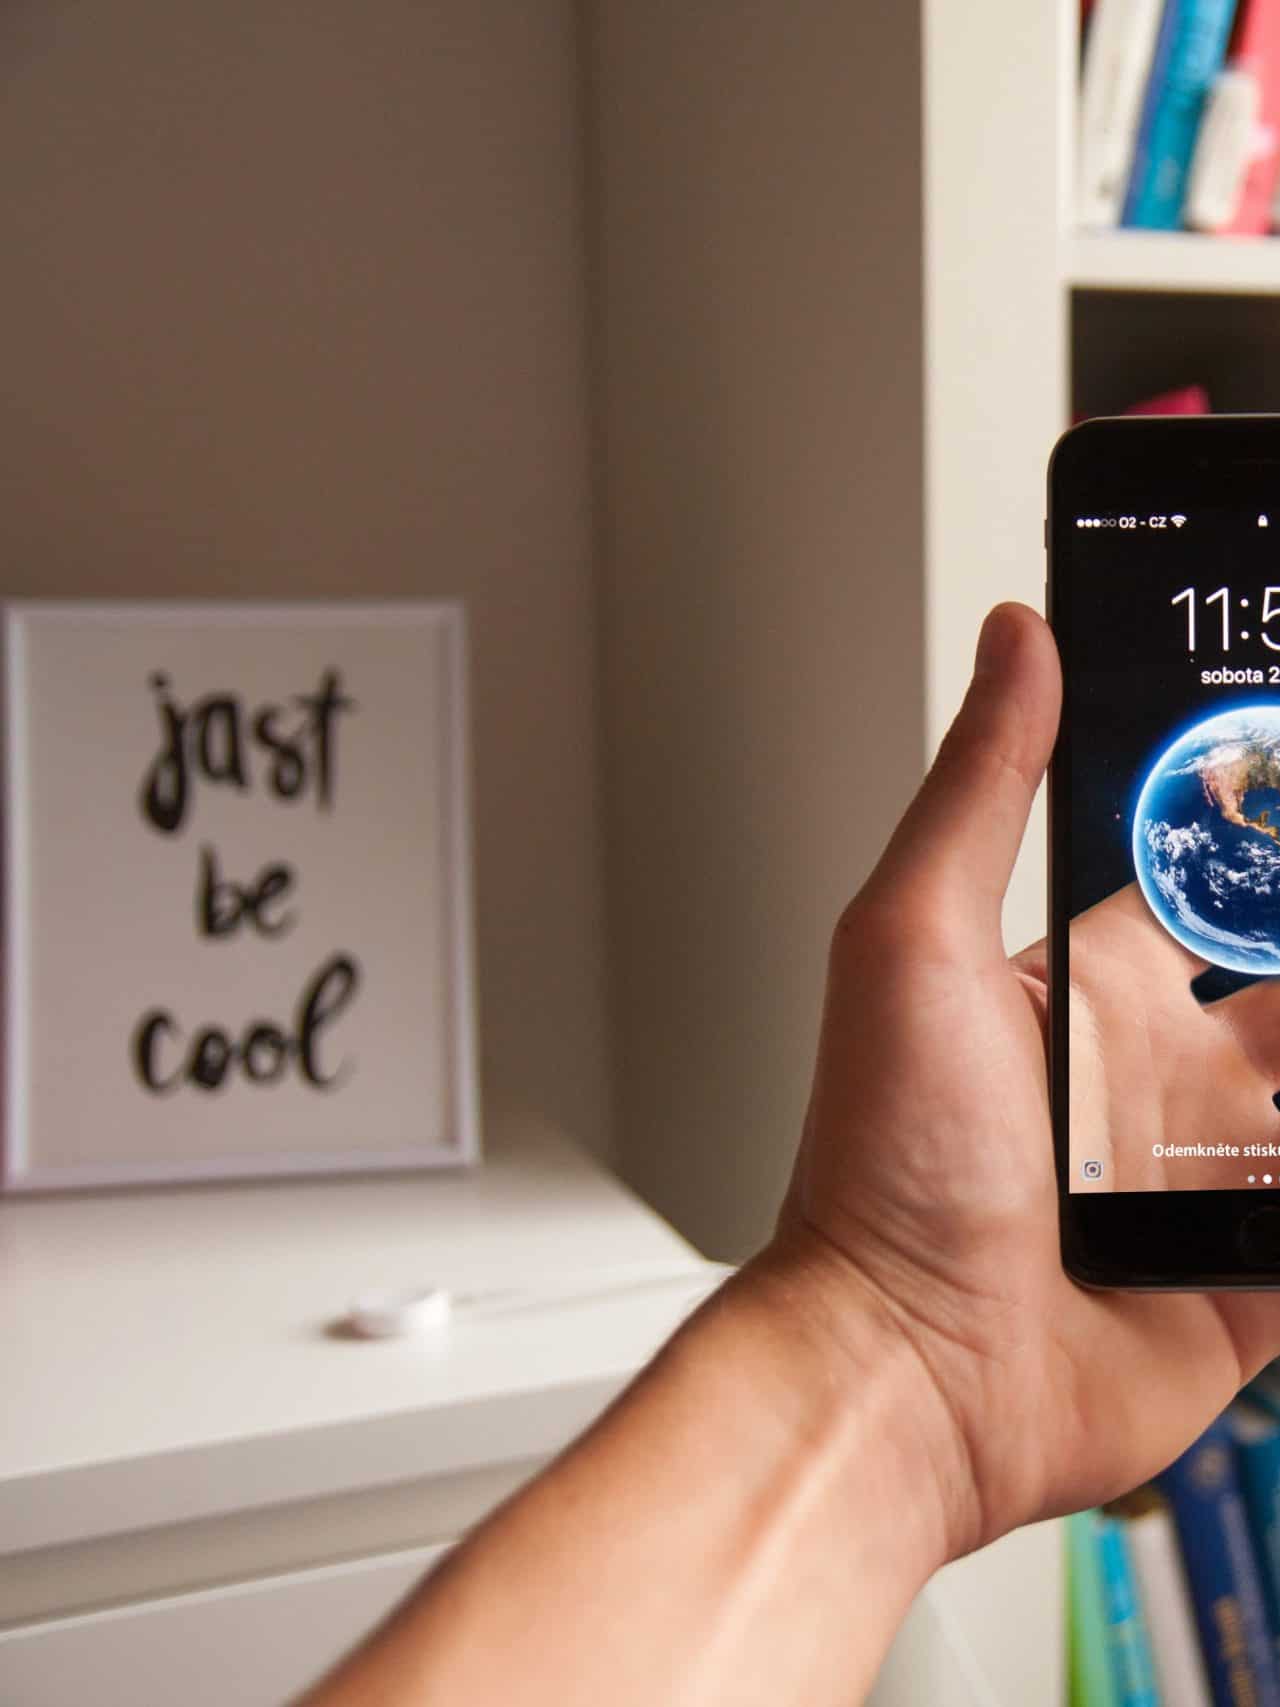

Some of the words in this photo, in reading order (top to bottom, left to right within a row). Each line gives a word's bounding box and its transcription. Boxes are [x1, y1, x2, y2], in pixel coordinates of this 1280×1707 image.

[1149, 516, 1167, 528] CZ
[1201, 666, 1263, 684] sobota
[196, 843, 296, 940] be
[131, 951, 360, 1094] cool
[1152, 1142, 1240, 1158] Odemkněte
